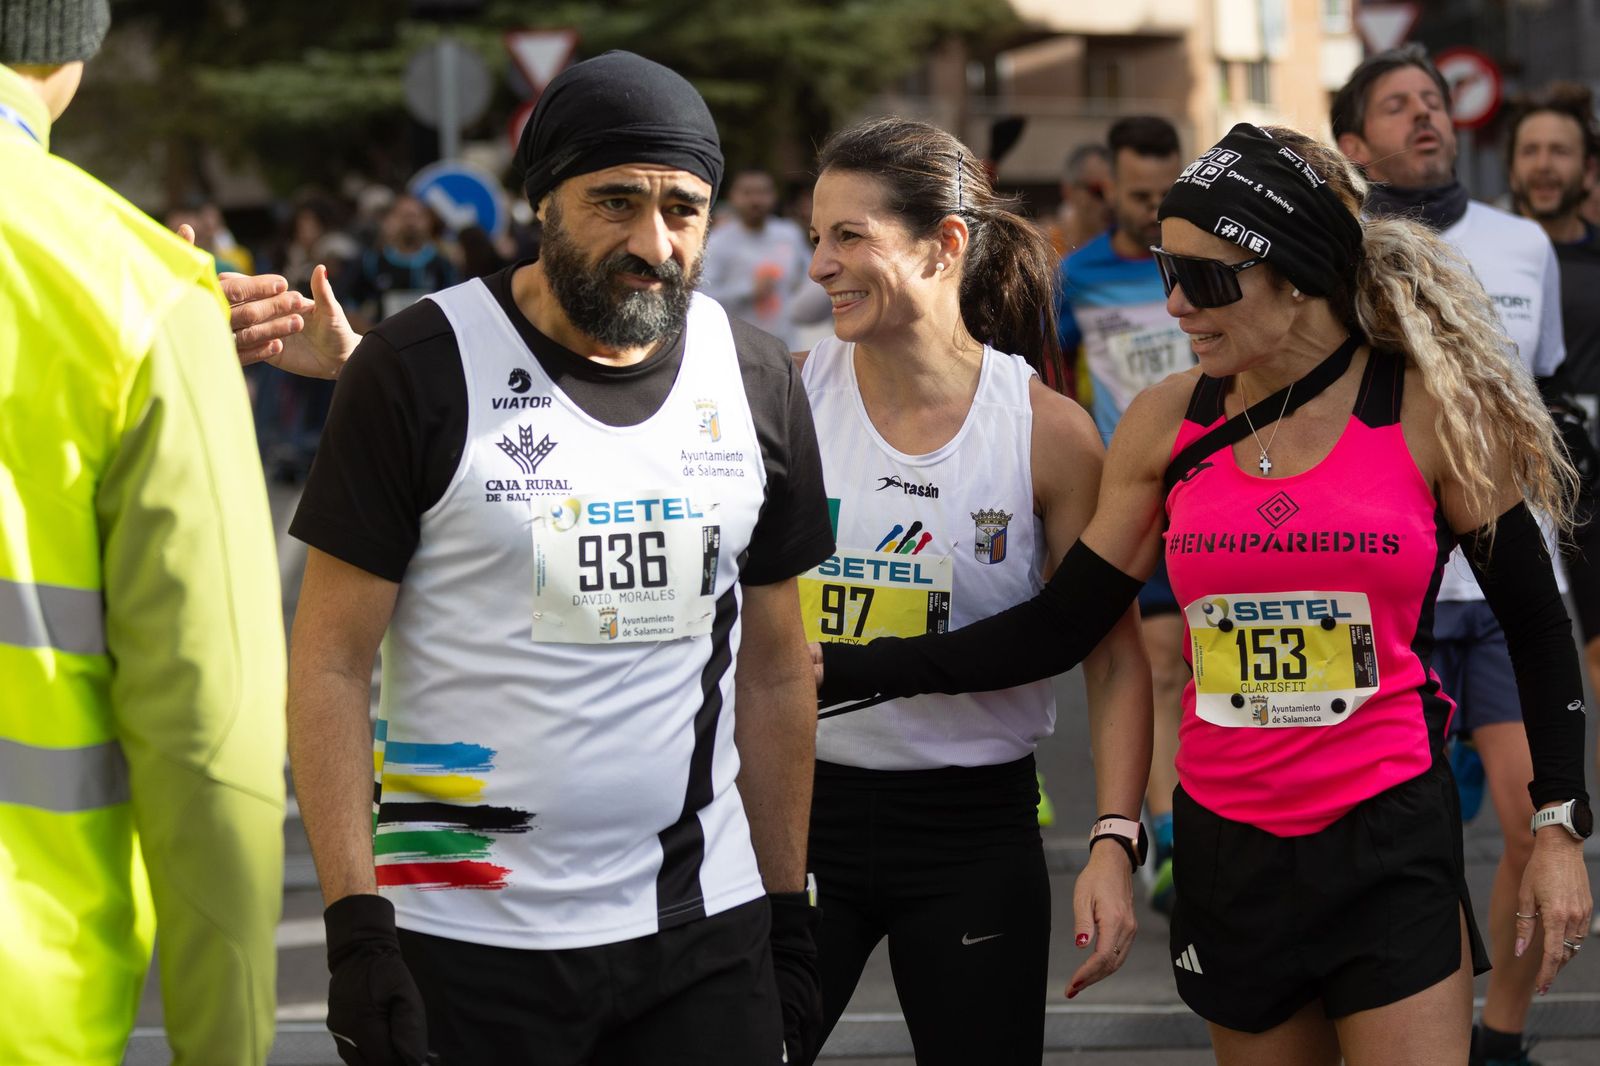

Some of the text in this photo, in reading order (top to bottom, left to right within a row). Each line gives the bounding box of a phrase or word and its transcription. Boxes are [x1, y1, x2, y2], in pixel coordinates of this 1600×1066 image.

[1226, 170, 1295, 214] Dance & Training
[492, 396, 552, 410] VIATOR
[680, 450, 744, 462] Ayuntamiento
[683, 465, 745, 478] de Salamanca
[485, 480, 573, 491] CAJA RURAL
[485, 493, 502, 502] DE
[587, 498, 704, 526] SETEL
[1169, 531, 1401, 555] #EN4PAREDES
[578, 531, 668, 592] 936
[818, 556, 933, 584] SETEL
[572, 589, 676, 606] DAVID MORALES
[821, 584, 875, 638] 97
[1233, 599, 1352, 622] SETEL
[622, 614, 675, 625] Ayuntamiento
[622, 626, 675, 636] de Salamanca
[1236, 628, 1307, 681] 153
[1240, 681, 1306, 693] CLARISFIT
[1271, 704, 1321, 714] Ayuntamiento
[1272, 714, 1322, 724] de Salamanca
